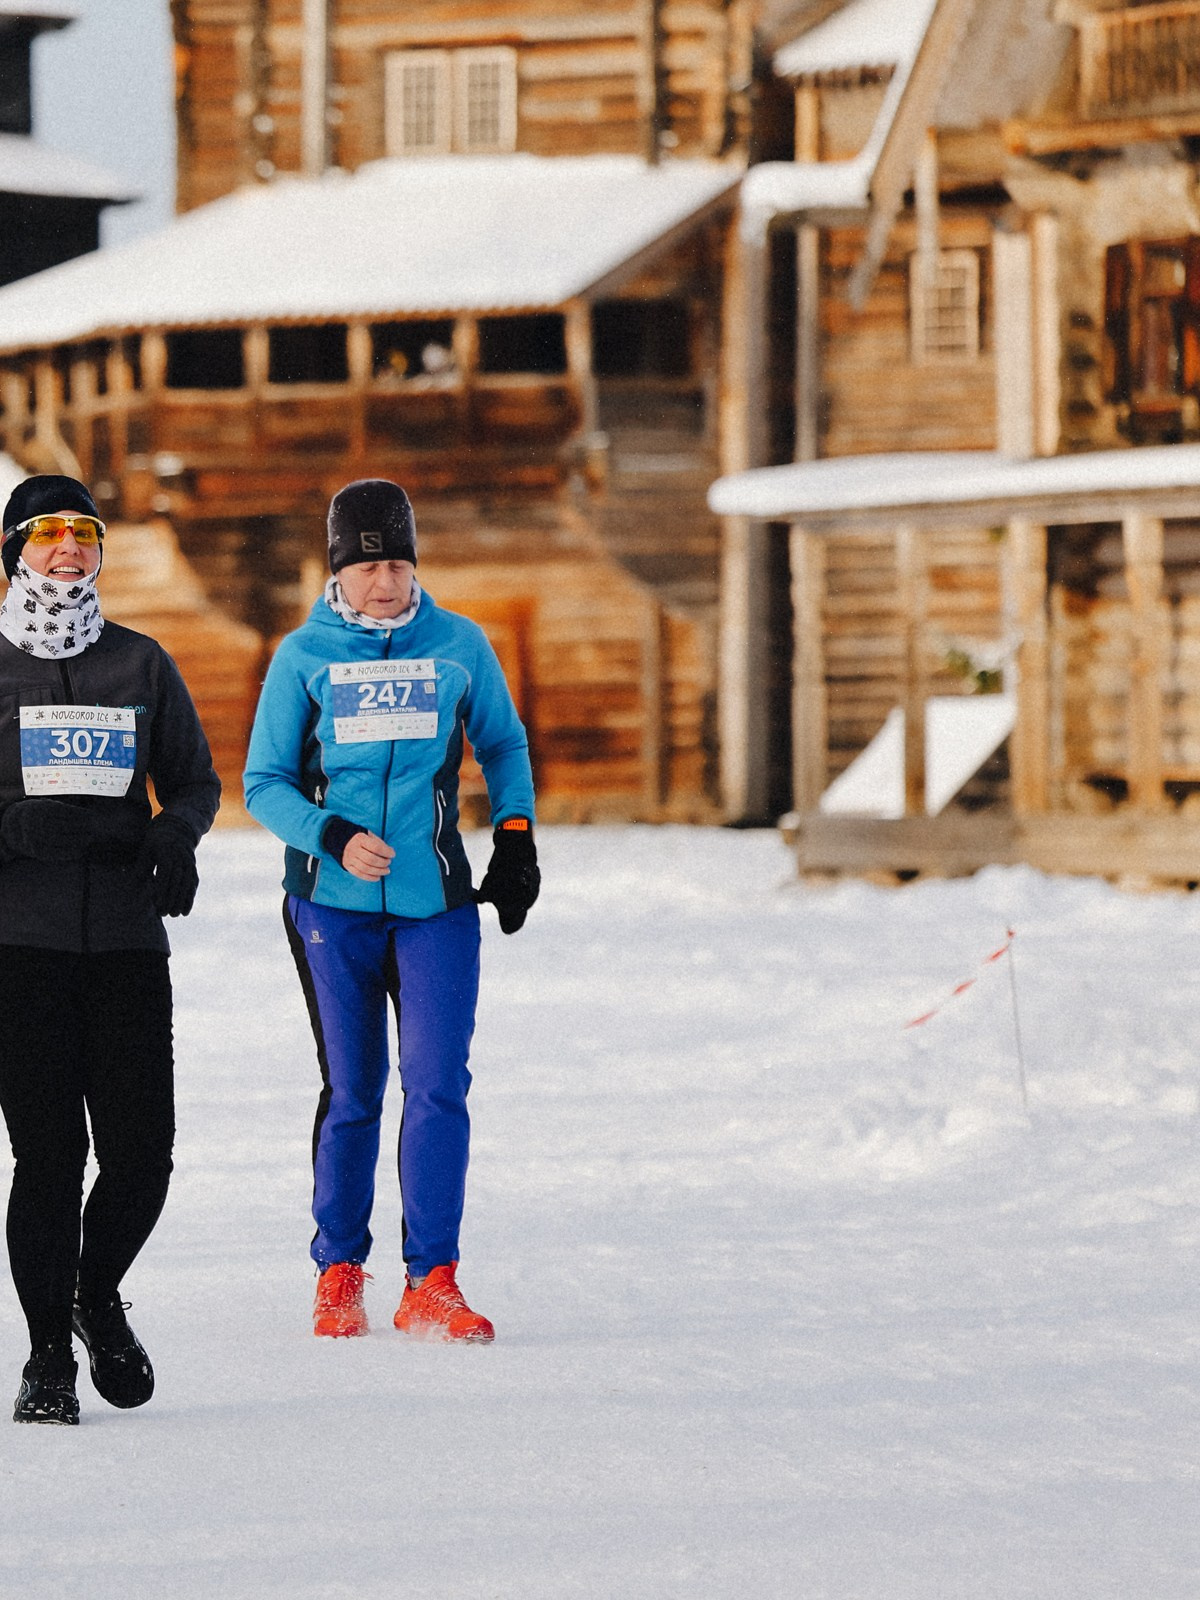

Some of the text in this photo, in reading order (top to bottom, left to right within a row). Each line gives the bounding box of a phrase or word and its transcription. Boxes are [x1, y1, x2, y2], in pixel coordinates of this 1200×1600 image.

[357, 665, 410, 675] NOVGOROD ICE
[357, 681, 413, 709] 247
[51, 710, 109, 723] NOVGOROD ICE
[50, 729, 110, 758] 307
[48, 758, 114, 767] ЛАНДЫШЕВА ЕЛЕНА
